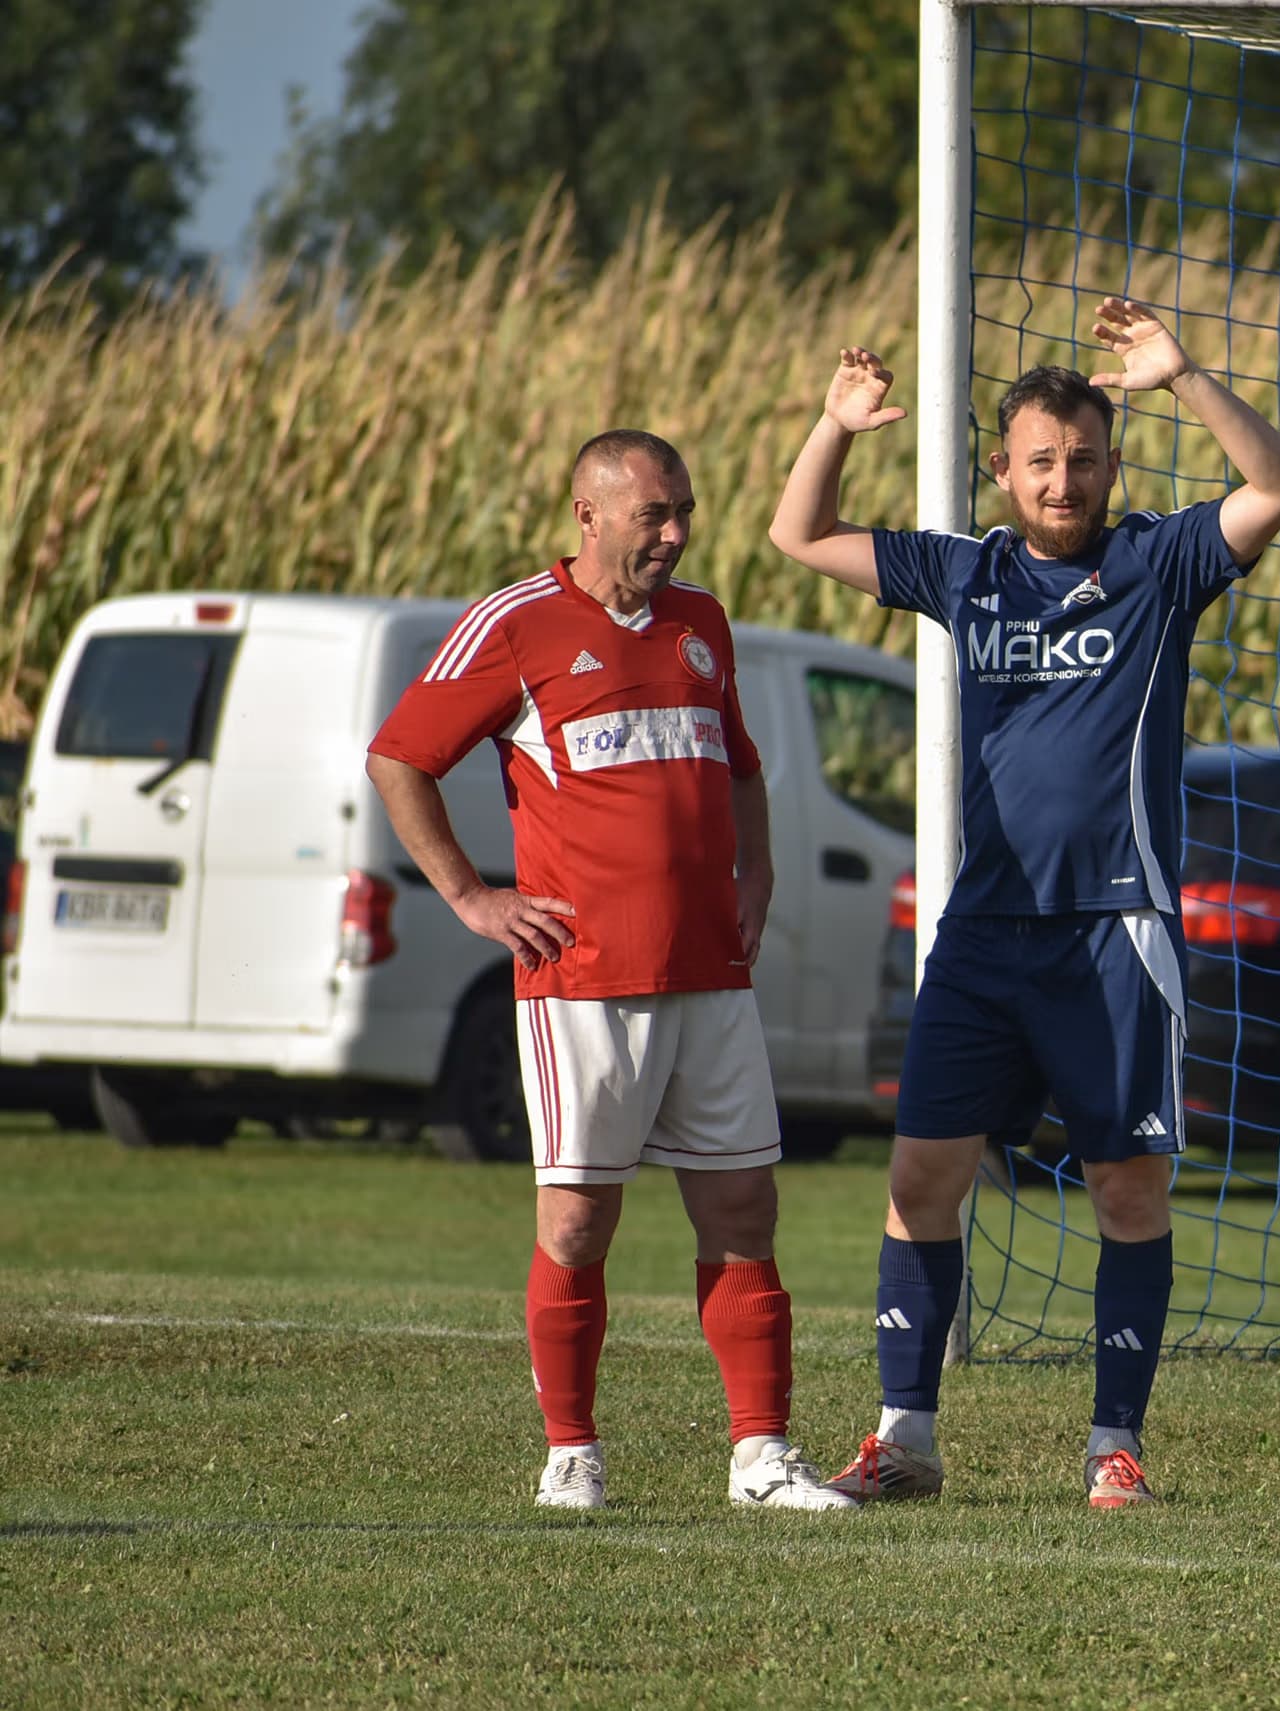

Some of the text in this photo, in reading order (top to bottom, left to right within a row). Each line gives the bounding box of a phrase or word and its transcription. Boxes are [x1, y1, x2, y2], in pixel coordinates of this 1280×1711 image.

[1006, 620, 1040, 633] PPHU
[967, 619, 1116, 671] MAKO
[570, 661, 604, 675] adidas
[1014, 668, 1102, 682] KORZENIOWSKI
